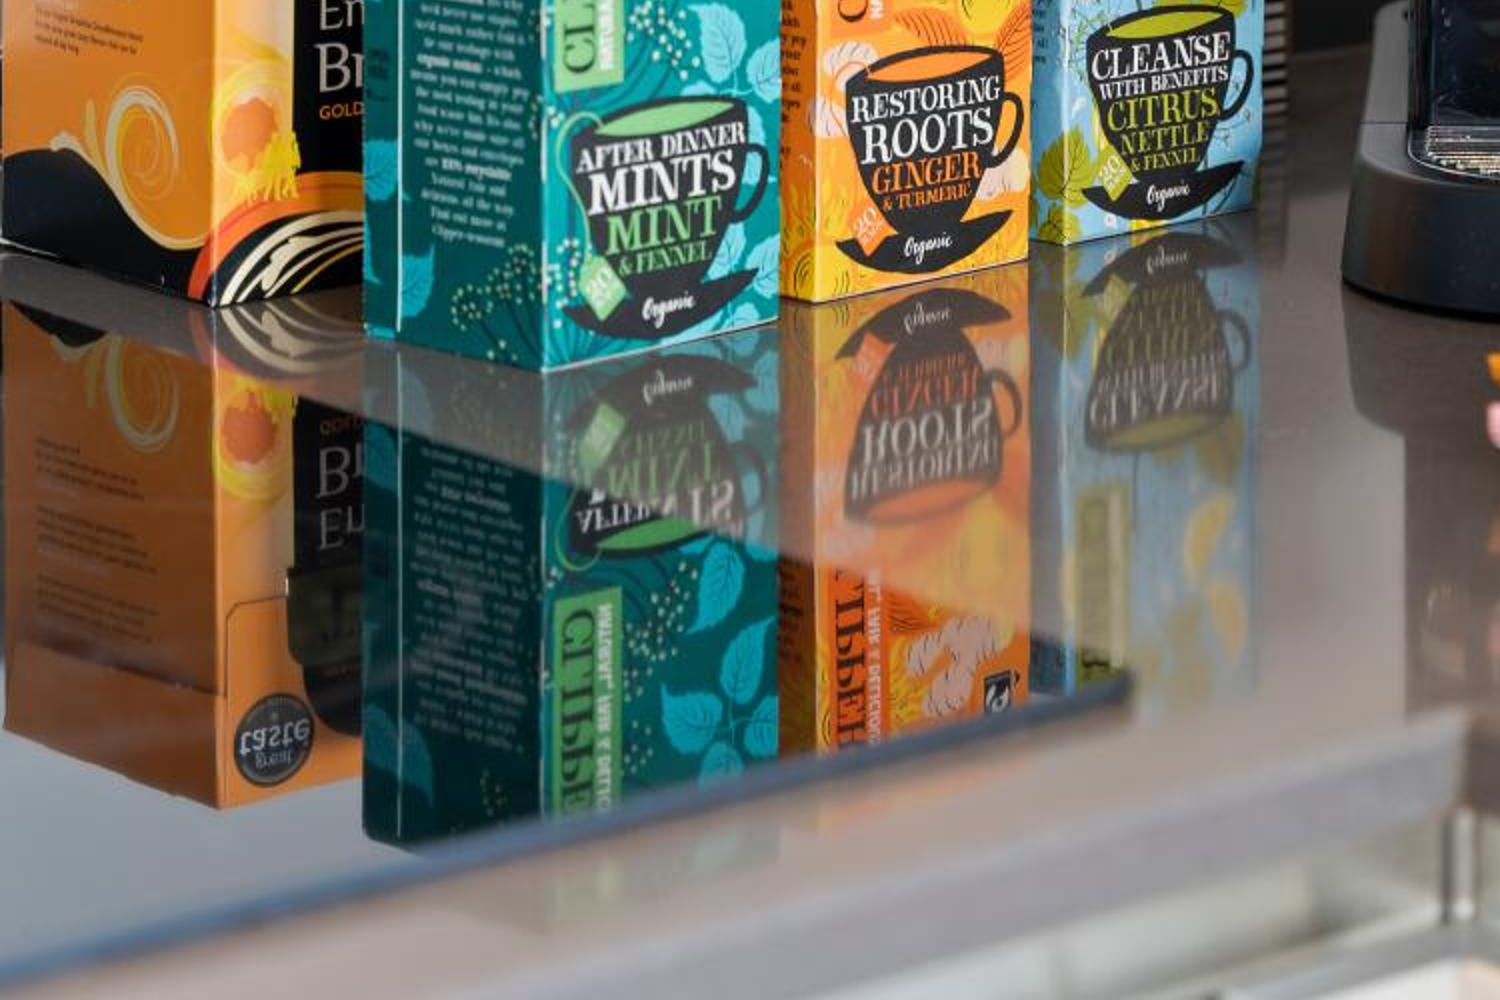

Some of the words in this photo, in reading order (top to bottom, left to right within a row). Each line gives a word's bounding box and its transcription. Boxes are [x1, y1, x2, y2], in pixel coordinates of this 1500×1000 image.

[1092, 31, 1231, 80] CLEANSE
[851, 75, 1001, 124] RESTORING
[1099, 77, 1146, 100] WITH
[1151, 65, 1229, 92] BENEFITS
[1107, 87, 1219, 131] CITRUS
[576, 137, 653, 174] AFTER
[661, 121, 746, 158] DINNER
[860, 107, 994, 165] ROOTS
[1121, 122, 1209, 155] NETTLE
[872, 151, 983, 195] GINGER
[1131, 159, 1142, 172] &
[1144, 147, 1197, 171] FENNEL
[588, 149, 737, 216] MINTS
[896, 183, 972, 210] TURMERIC
[1146, 179, 1191, 213] Organic
[605, 195, 722, 256] MINT
[619, 256, 634, 276] &
[636, 240, 712, 274] FENNEL
[904, 232, 953, 265] Organic
[642, 291, 696, 329] Organic
